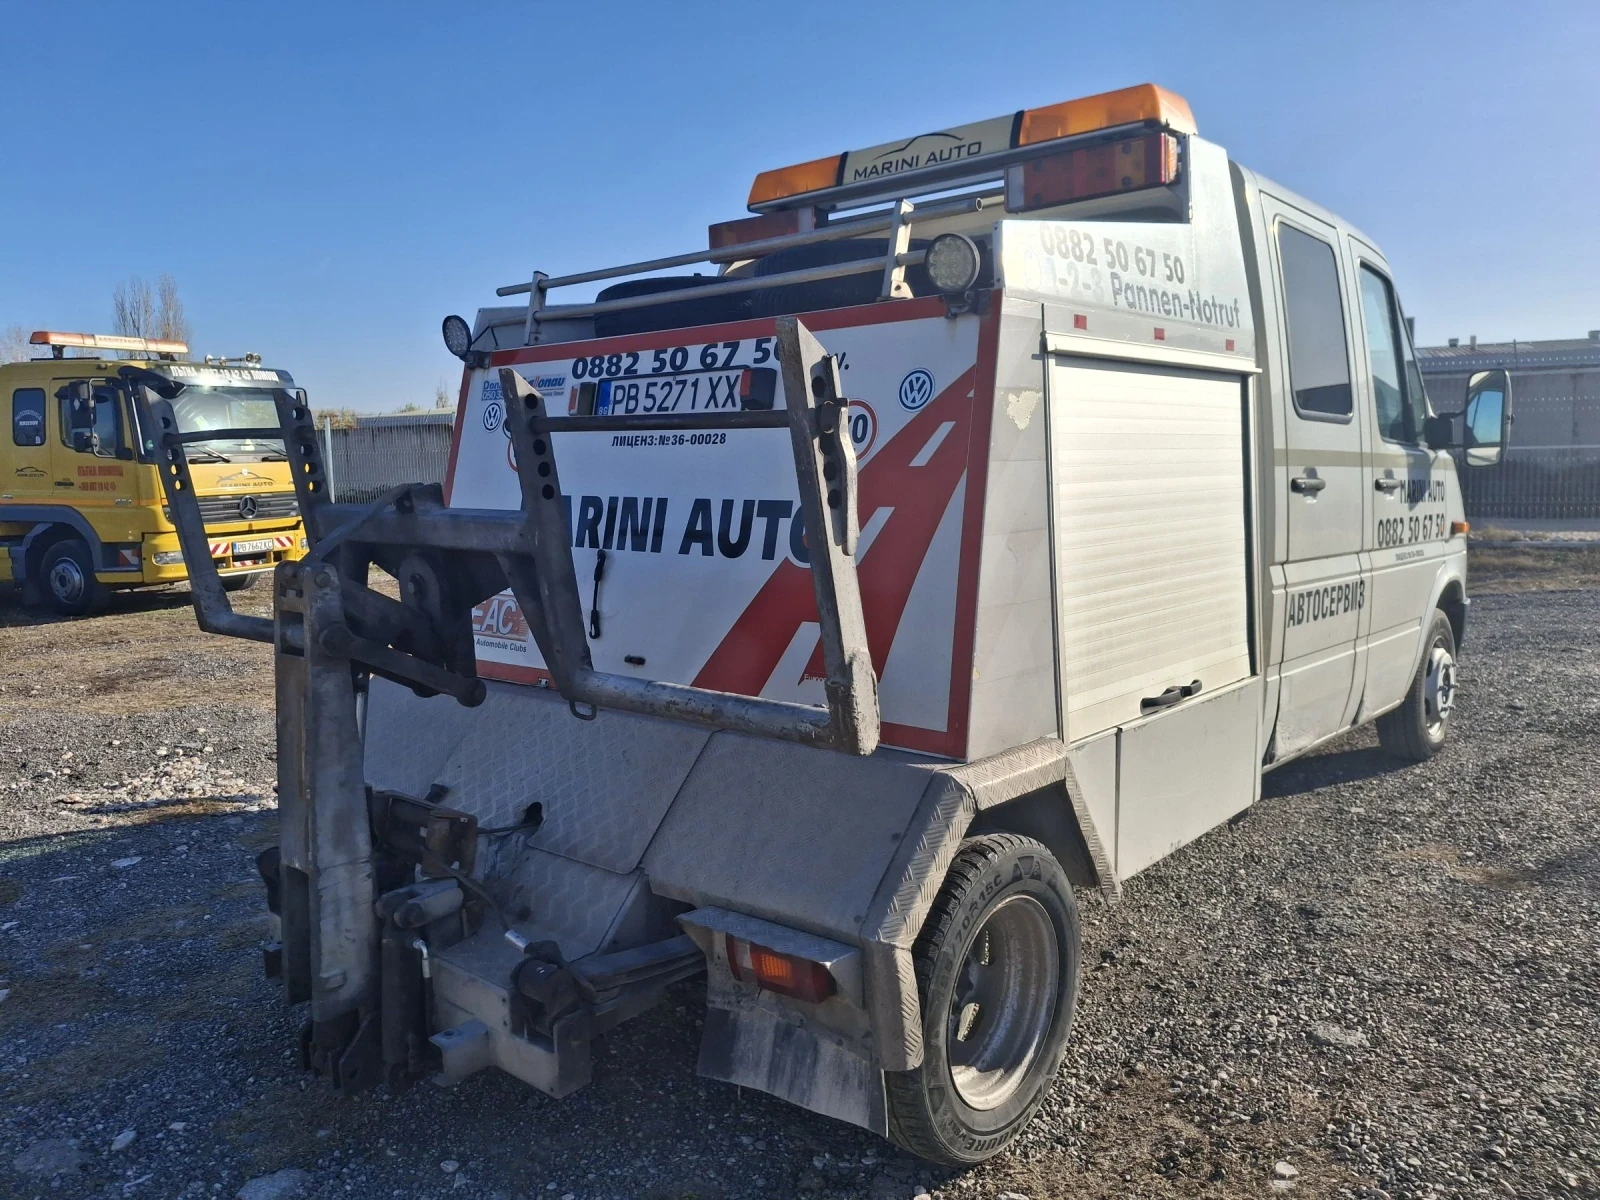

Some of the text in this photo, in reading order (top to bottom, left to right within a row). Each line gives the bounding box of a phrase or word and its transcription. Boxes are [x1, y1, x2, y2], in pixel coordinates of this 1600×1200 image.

[854, 141, 982, 181] MARINI AUTO
[1040, 221, 1186, 285] 0882 50 67 50
[1110, 271, 1241, 328] Pannen-Notruf
[571, 337, 781, 380] 0882 50 67 5
[483, 380, 502, 390] Don
[612, 373, 742, 415] PB 5271 XX
[1427, 480, 1445, 503] AUTO
[561, 494, 669, 554] RINI
[1377, 512, 1445, 548] 0882 50 67 50
[247, 541, 263, 551] 7662
[1286, 579, 1366, 629] АВТОСЕРВИЗ
[476, 637, 528, 653] Automobile Clubs
